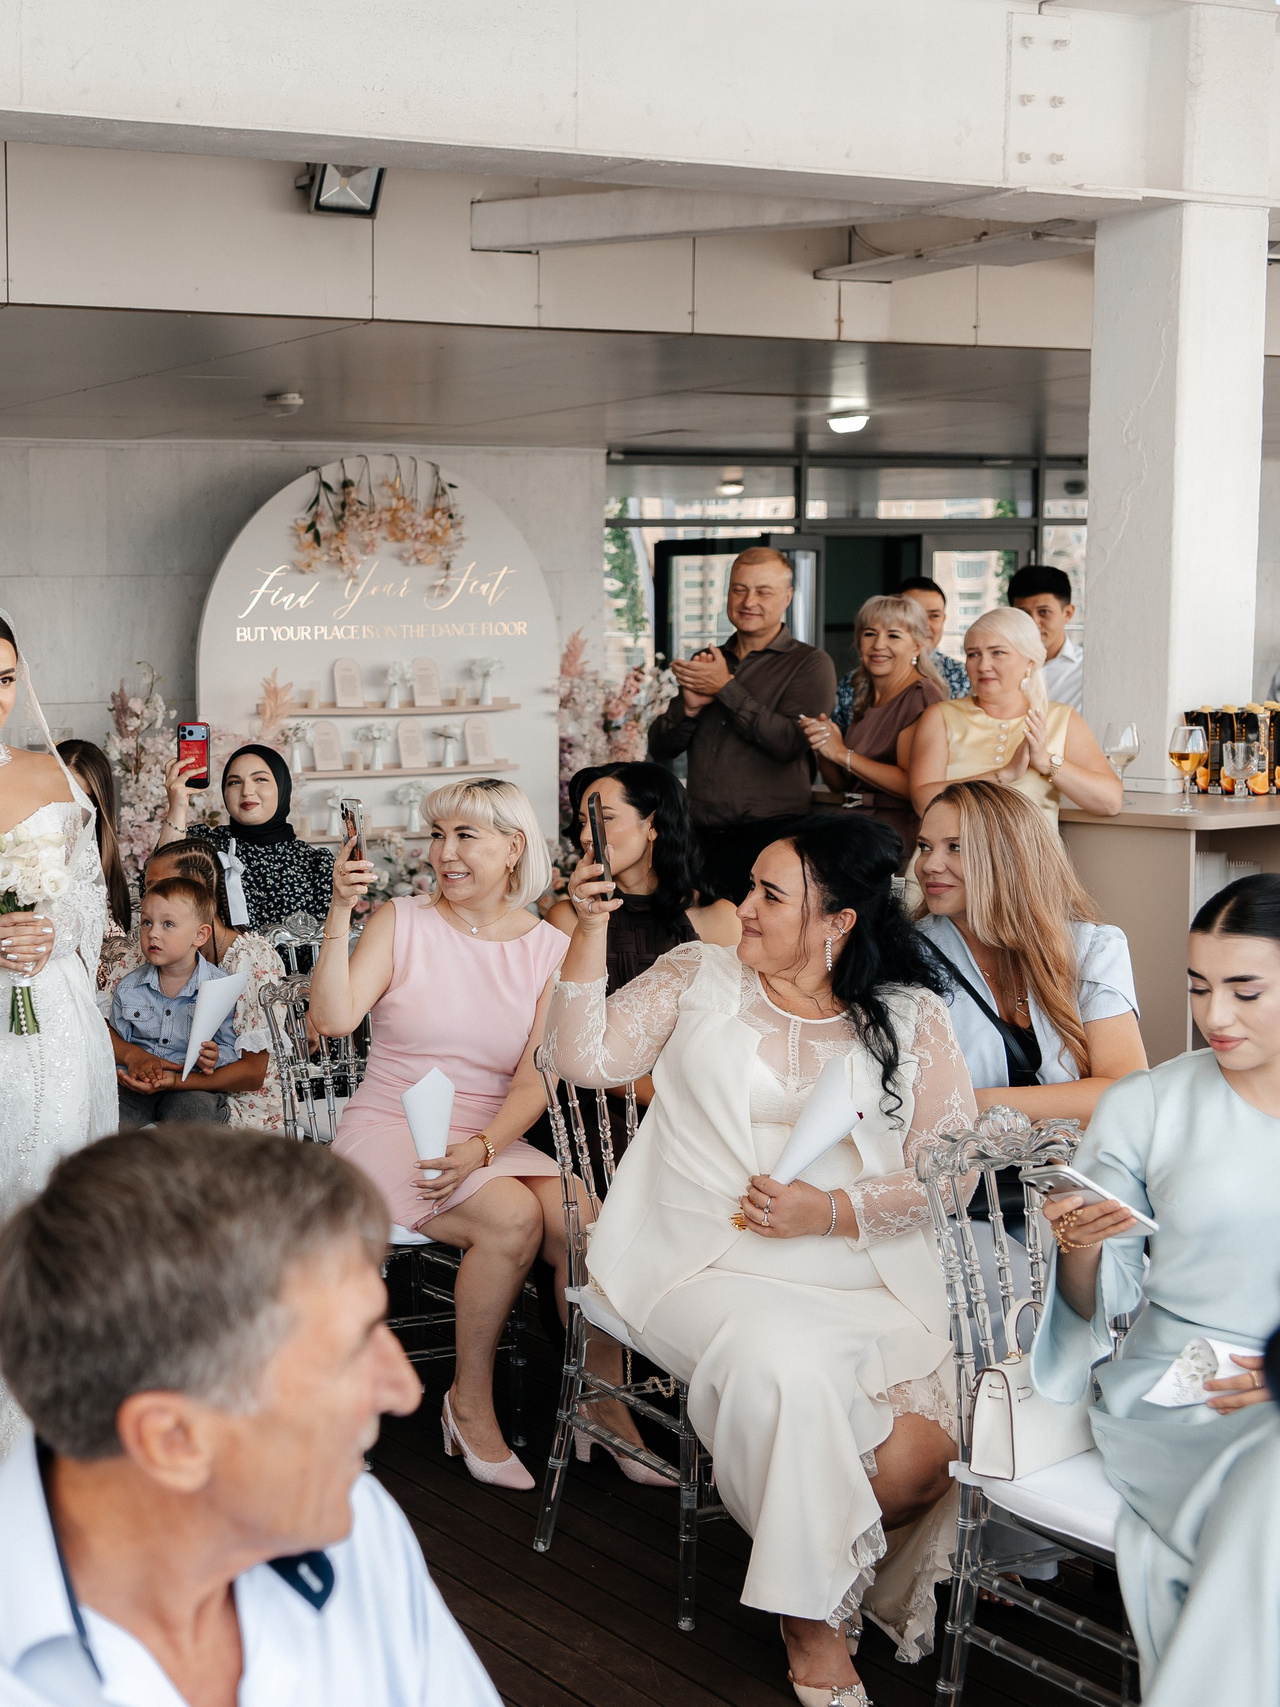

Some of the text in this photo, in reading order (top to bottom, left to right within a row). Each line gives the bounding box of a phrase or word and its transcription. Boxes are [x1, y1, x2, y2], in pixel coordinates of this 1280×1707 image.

[237, 559, 519, 620] Find Your Seat
[236, 620, 529, 642] BUT YOUR PLACE IS ON THE DANCE FLOOR
